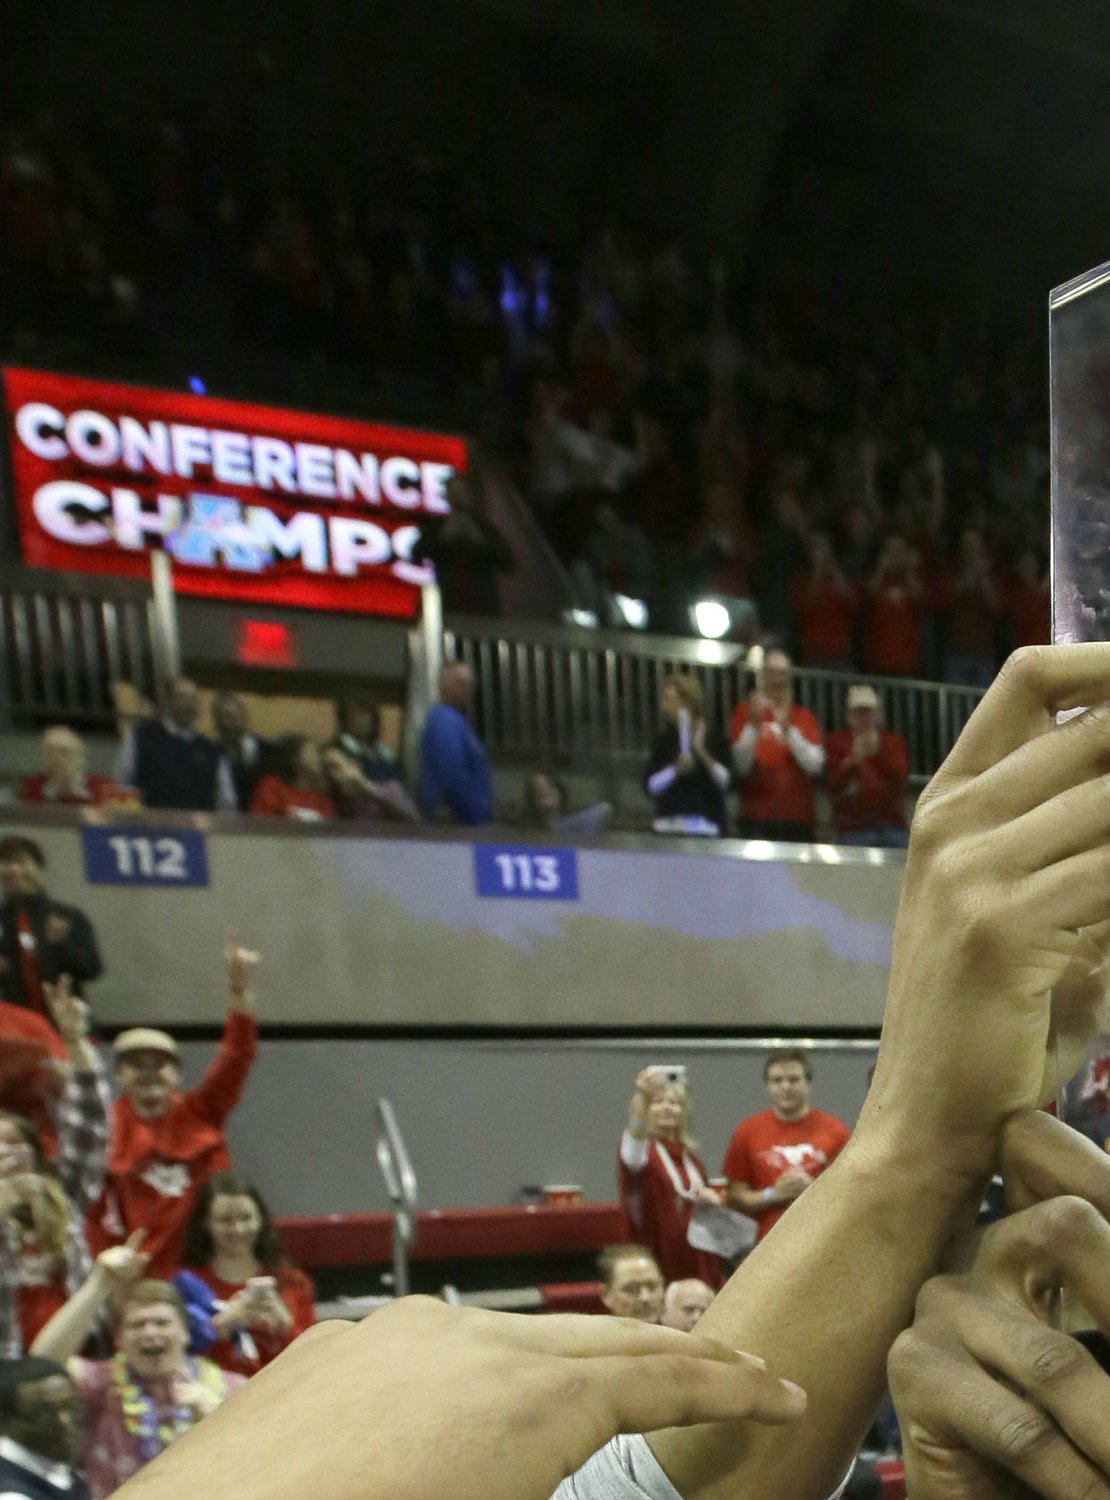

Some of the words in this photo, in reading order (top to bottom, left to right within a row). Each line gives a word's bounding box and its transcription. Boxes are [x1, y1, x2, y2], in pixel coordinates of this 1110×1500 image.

[15, 402, 455, 514] CONFERENCE
[33, 479, 437, 586] CHAMPS
[108, 836, 188, 879] 112
[494, 854, 561, 892] 113
